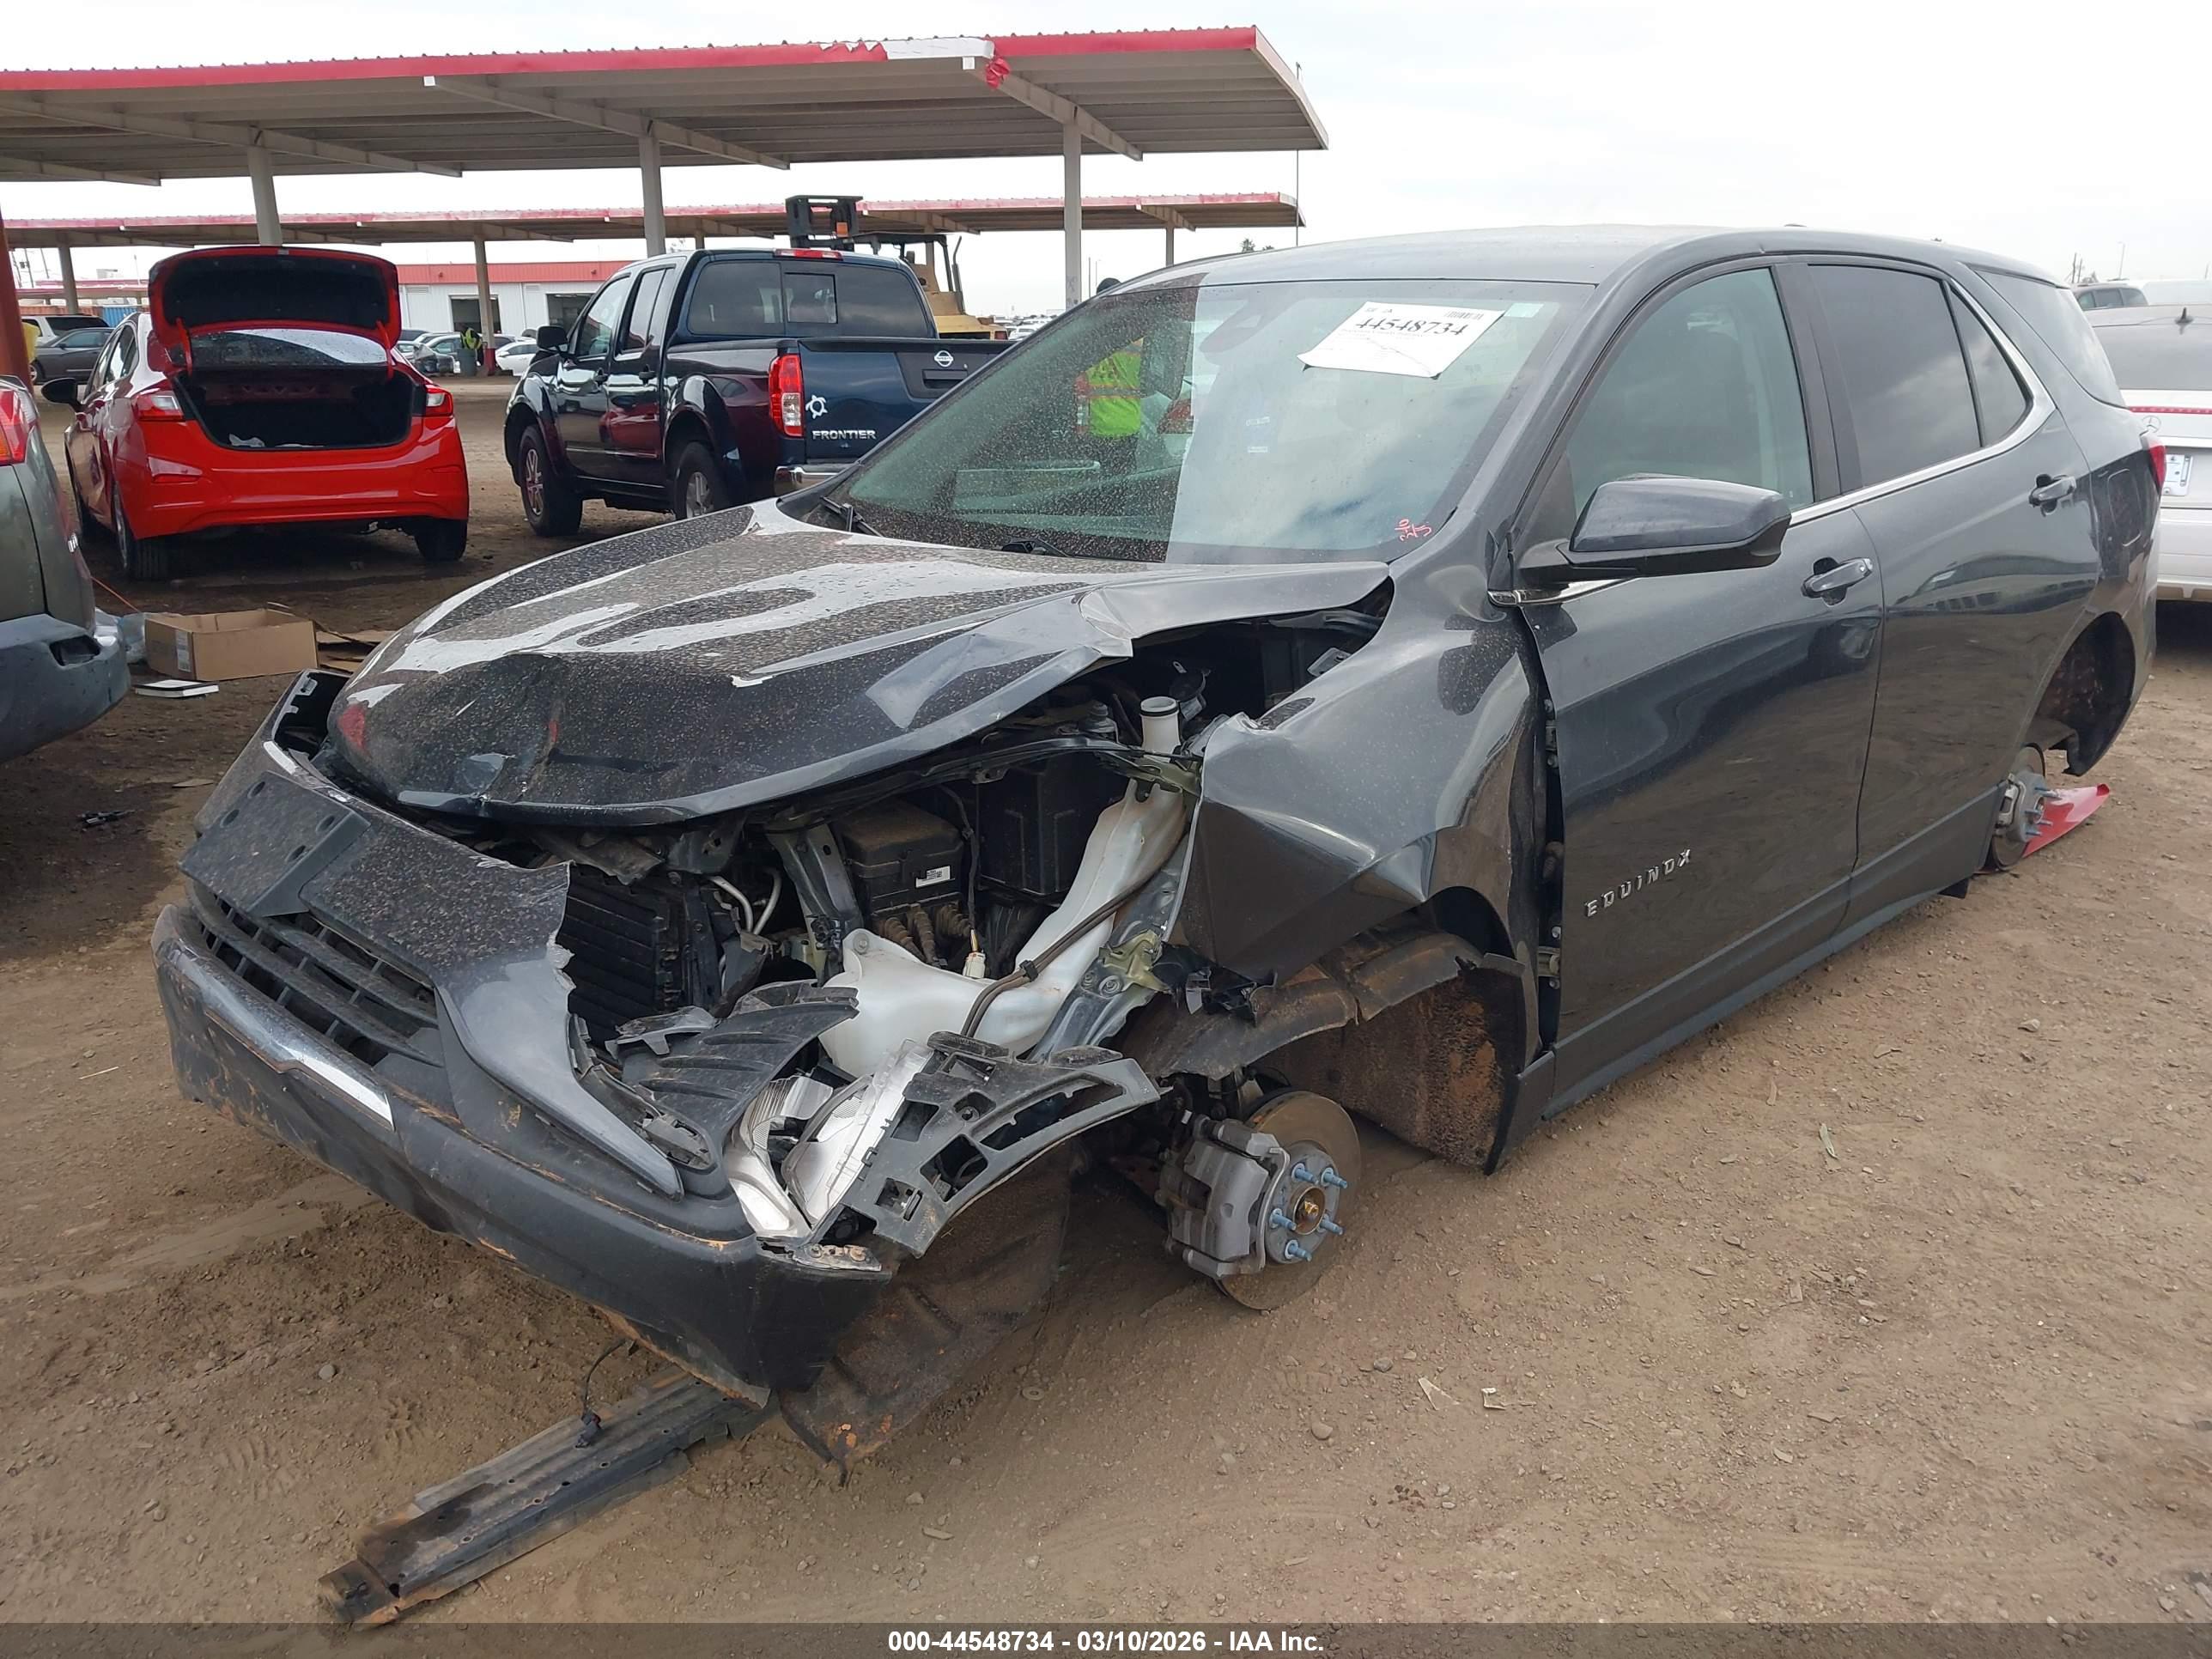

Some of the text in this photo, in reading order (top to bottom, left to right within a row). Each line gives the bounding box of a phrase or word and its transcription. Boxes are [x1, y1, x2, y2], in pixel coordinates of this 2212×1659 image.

[1355, 317, 1469, 336] 44548734
[811, 429, 877, 441] FRONTIER
[1584, 848, 1692, 918] EQUINOX
